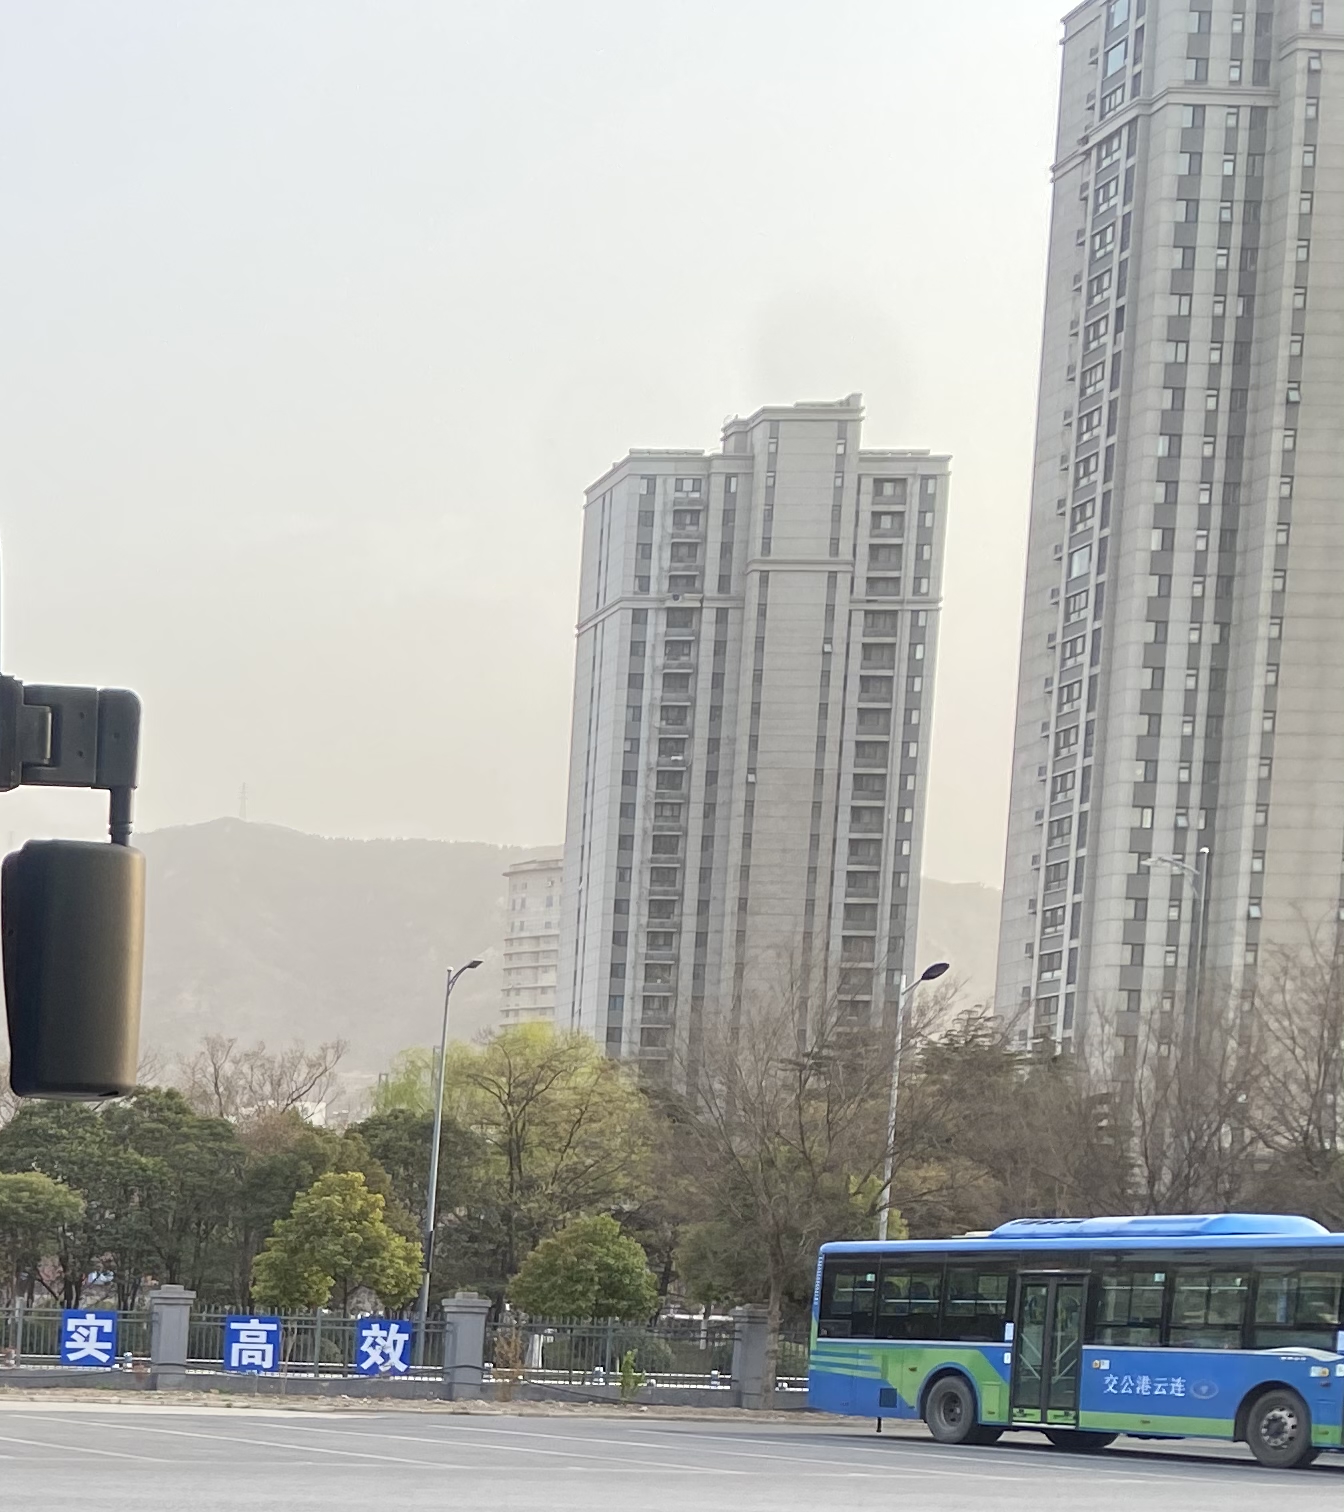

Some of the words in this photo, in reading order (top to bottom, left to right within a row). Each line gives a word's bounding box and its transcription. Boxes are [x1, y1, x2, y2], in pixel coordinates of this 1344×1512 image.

[64, 1313, 114, 1363] 实
[229, 1318, 276, 1369] 高
[359, 1322, 410, 1374] 效
